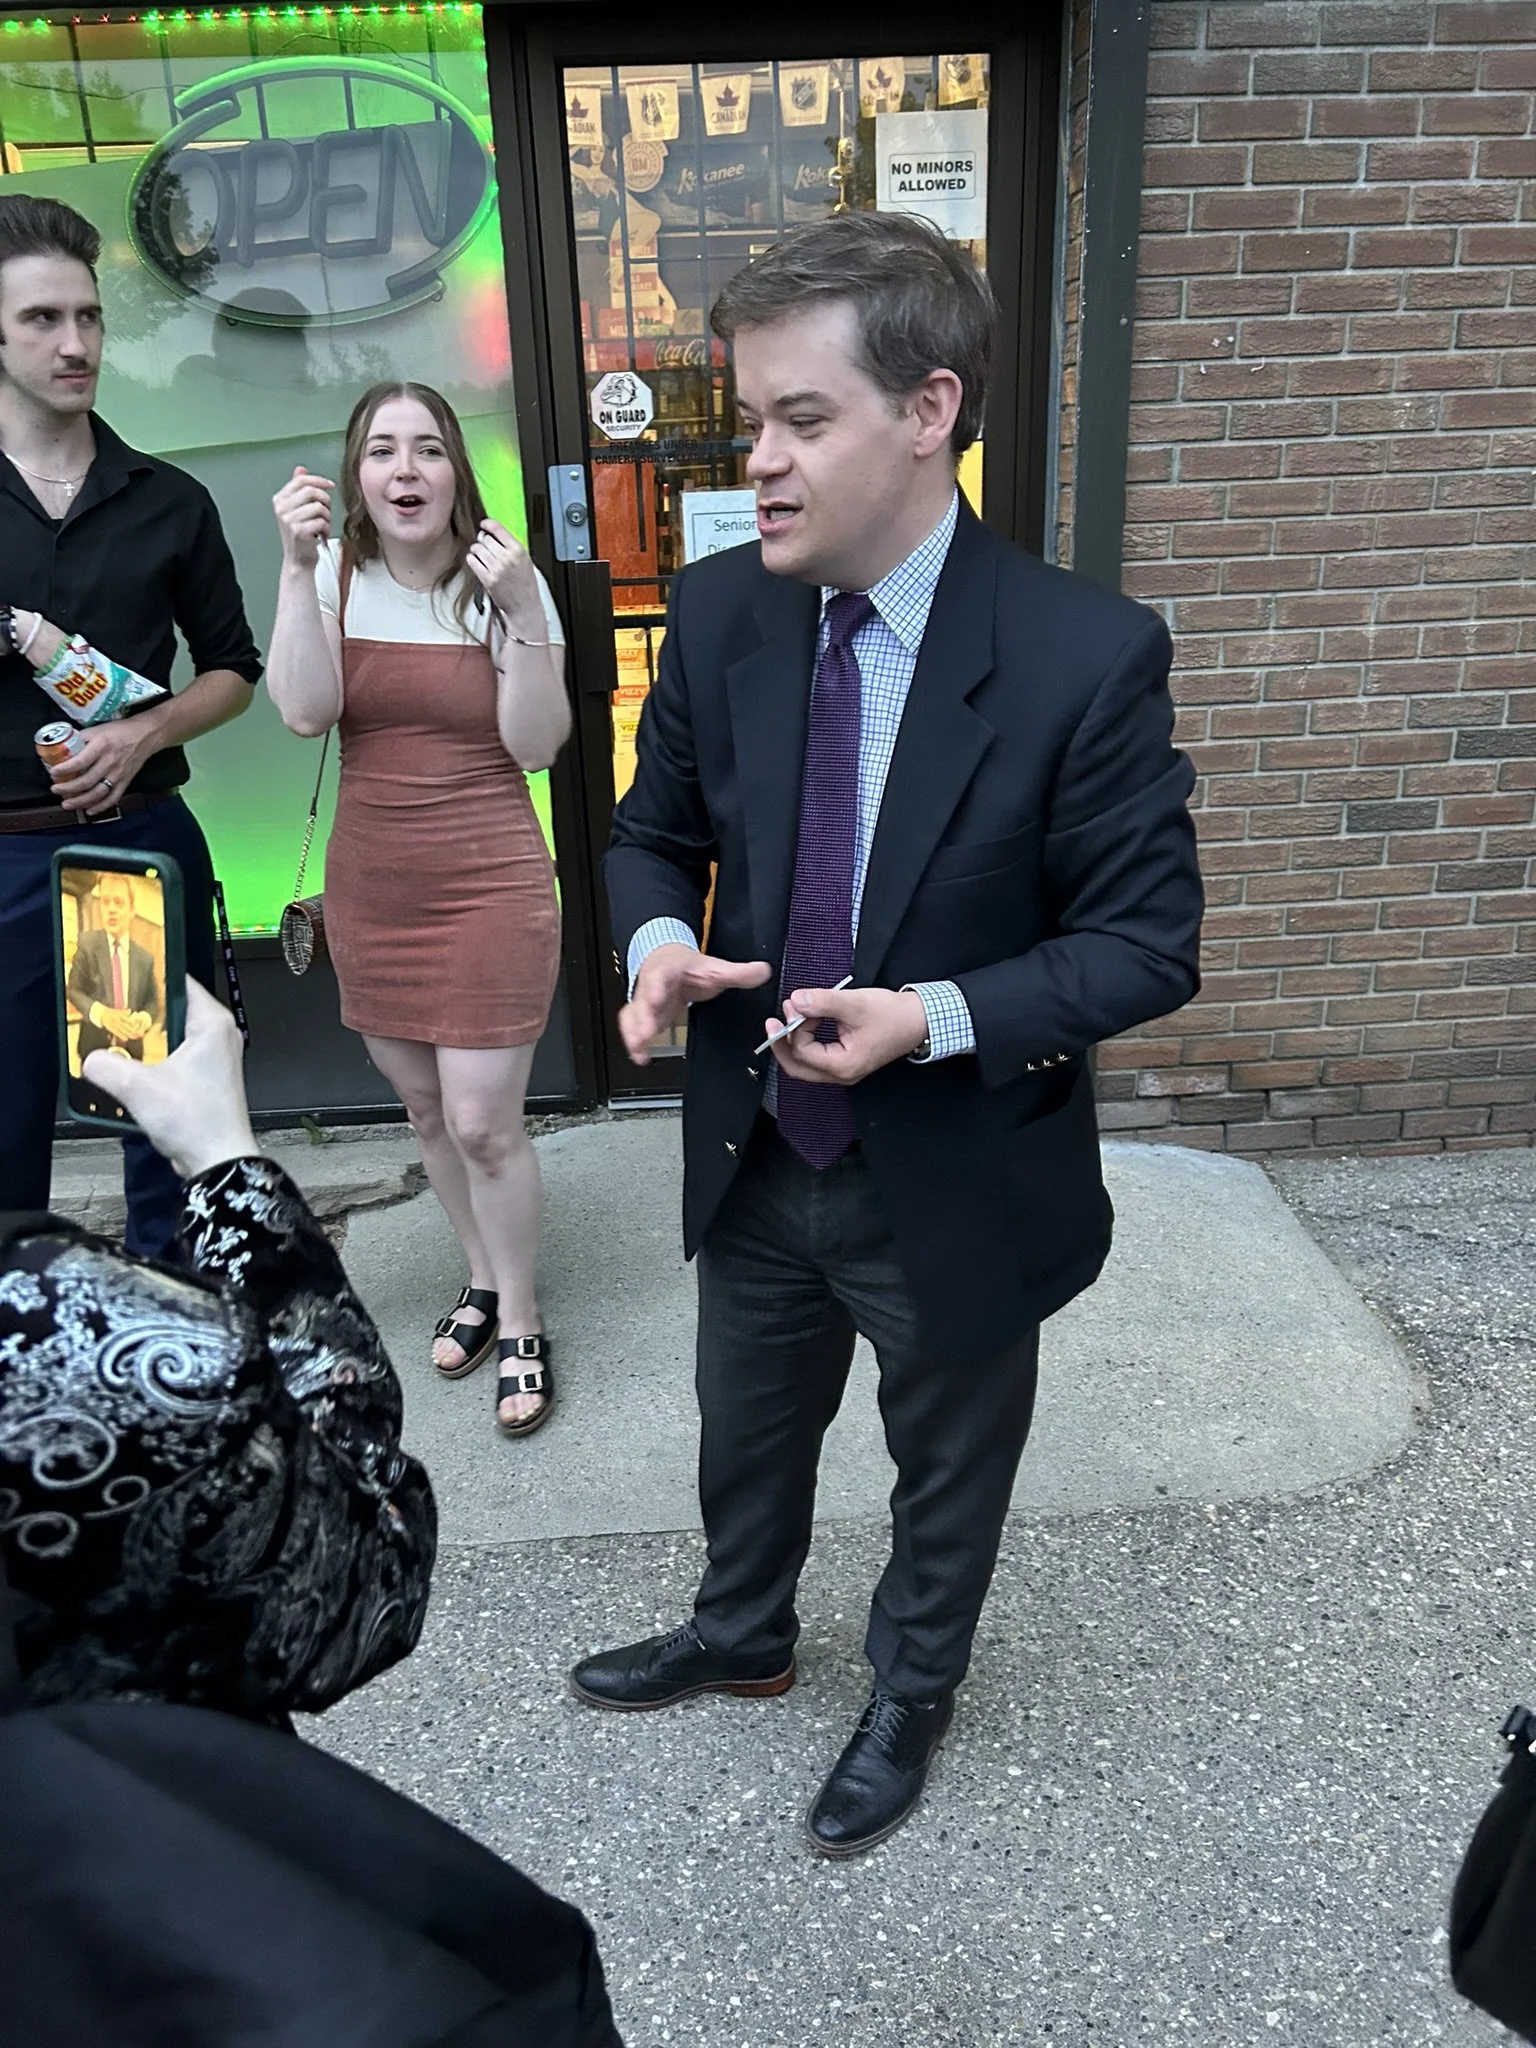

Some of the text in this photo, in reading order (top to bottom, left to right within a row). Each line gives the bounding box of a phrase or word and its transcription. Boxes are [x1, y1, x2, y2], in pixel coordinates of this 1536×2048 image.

[891, 160, 973, 175] NO MINORS
[898, 178, 966, 192] ALLOWED
[150, 118, 452, 268] OPEN
[600, 409, 646, 424] ON GUARD
[605, 424, 642, 432] SECURITY
[594, 454, 637, 465] CAMERA
[54, 671, 87, 696] Old
